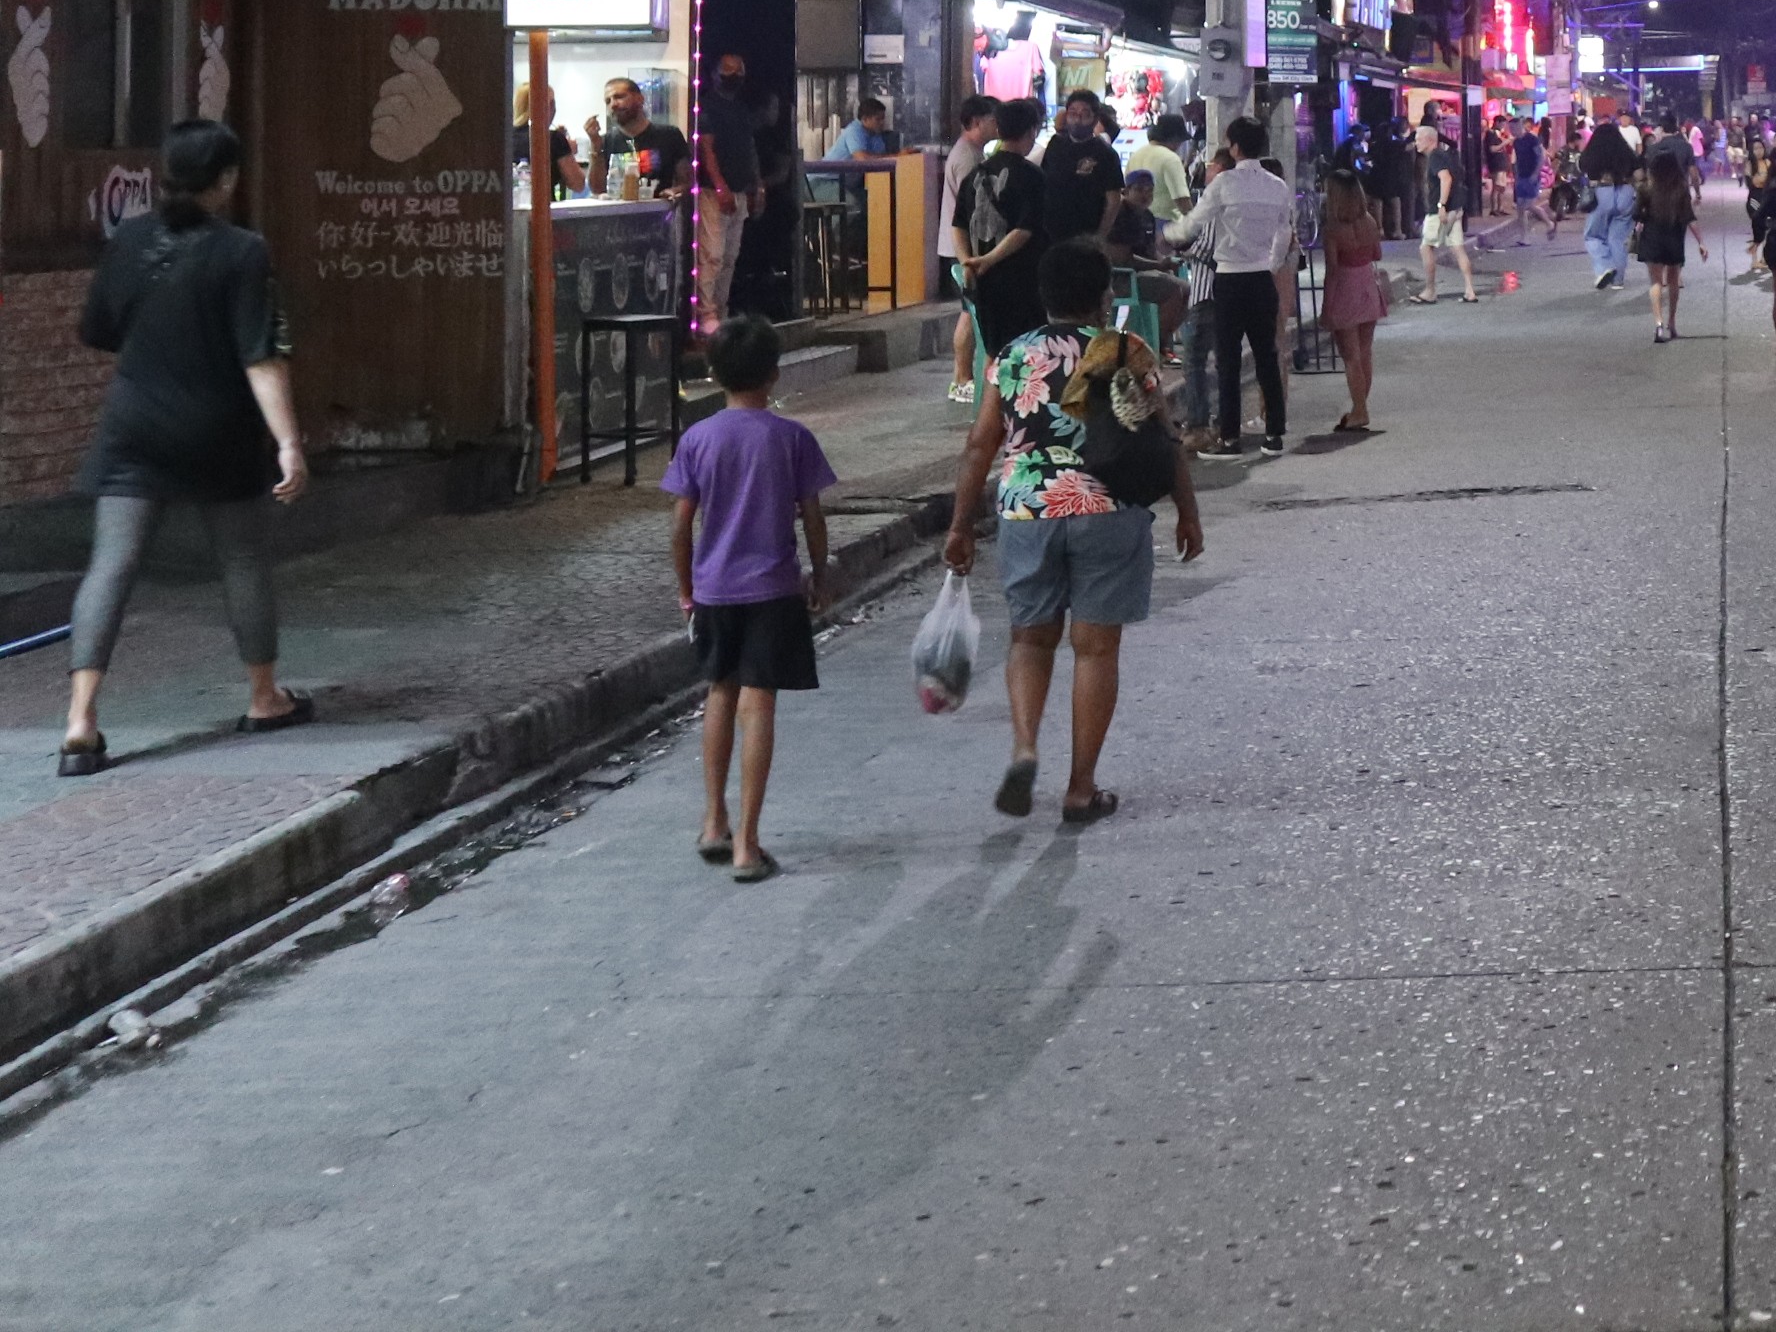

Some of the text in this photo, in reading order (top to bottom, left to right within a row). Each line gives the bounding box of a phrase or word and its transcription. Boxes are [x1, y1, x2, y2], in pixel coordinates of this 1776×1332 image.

[315, 170, 501, 194] Welcome to OPPA
